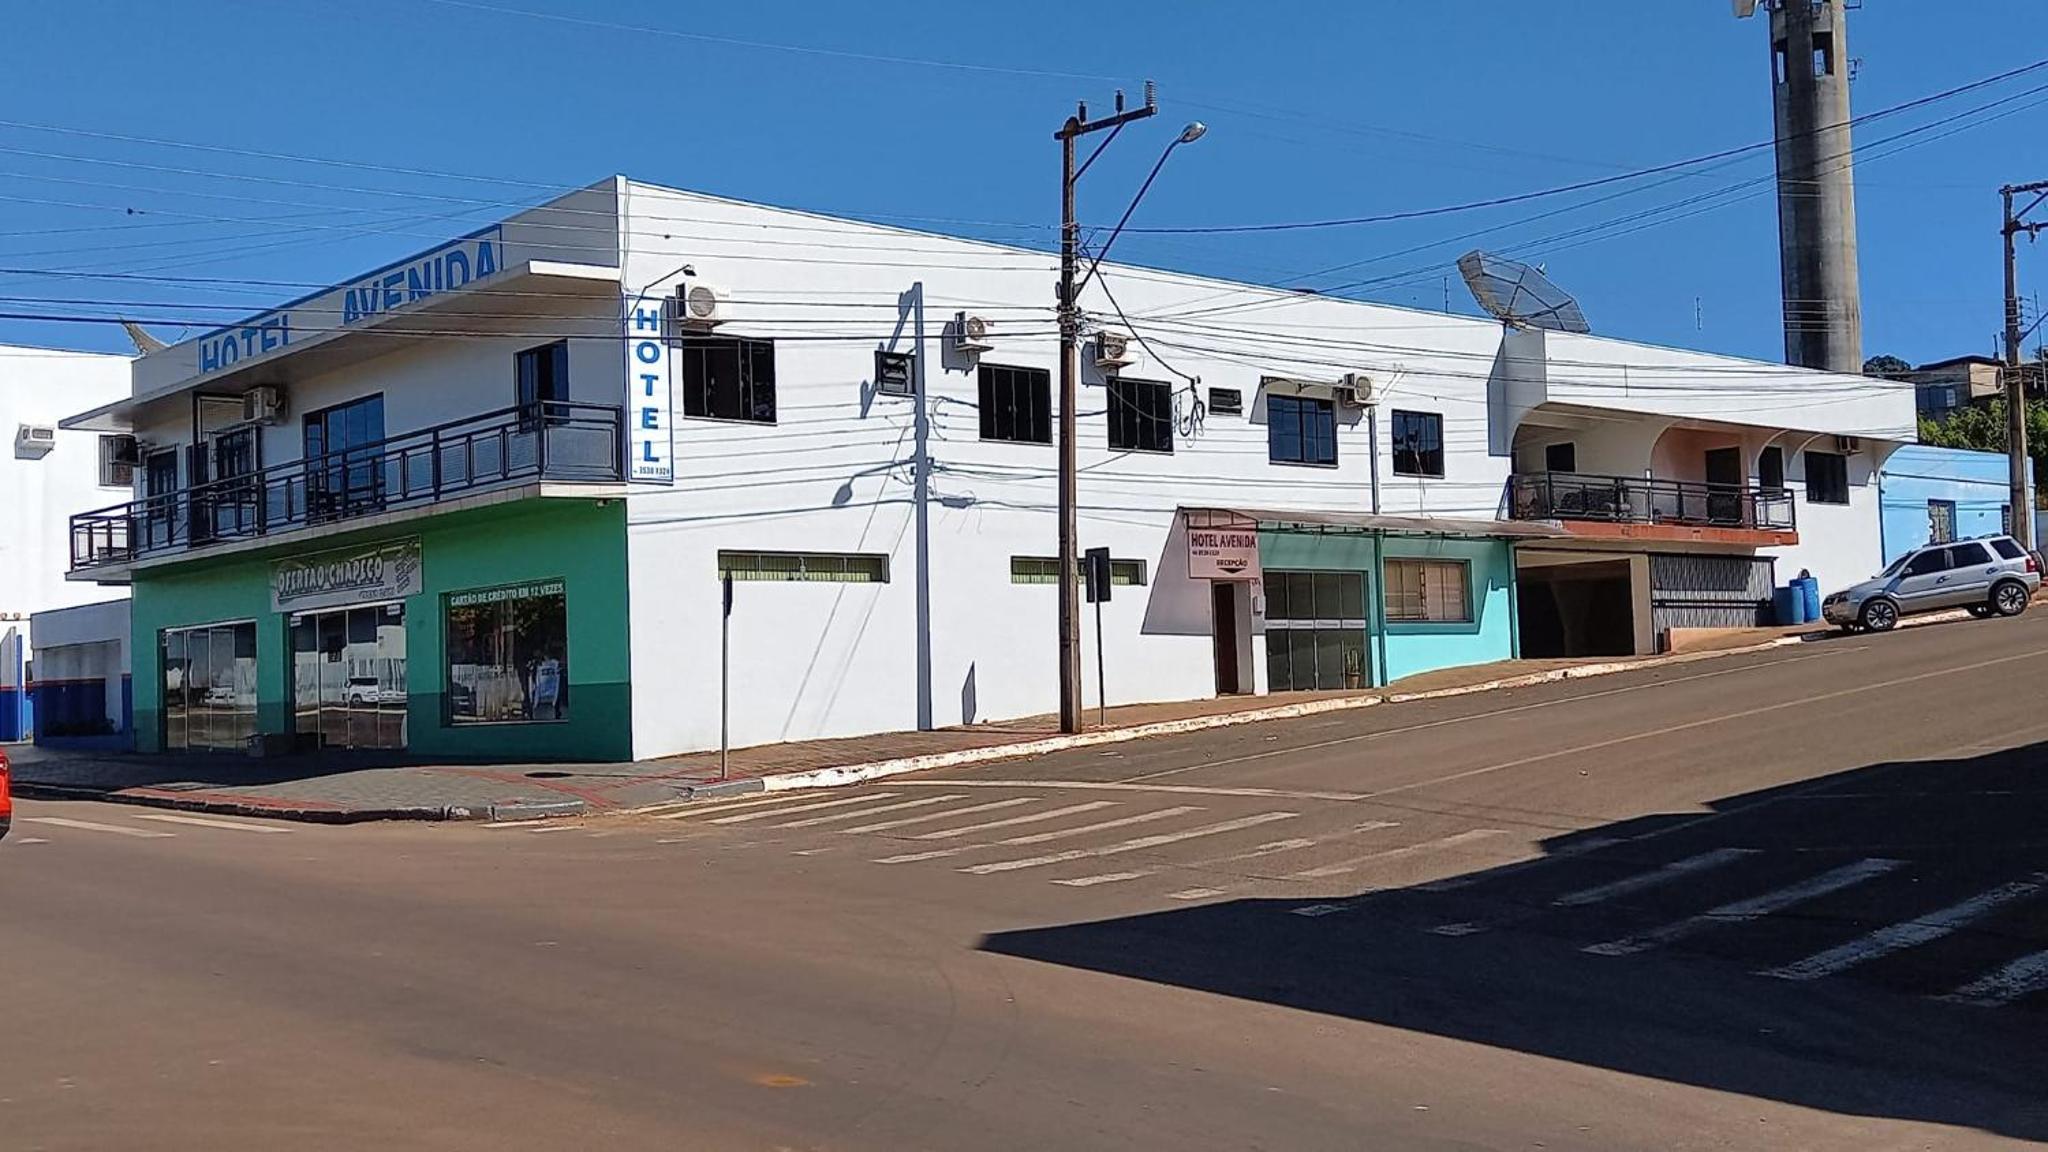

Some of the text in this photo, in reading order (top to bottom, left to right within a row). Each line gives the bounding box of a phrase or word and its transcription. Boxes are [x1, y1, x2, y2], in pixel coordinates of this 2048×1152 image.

[202, 239, 496, 374] HOTEL AVENIDA
[636, 308, 660, 463] HOTEL
[1191, 533, 1256, 548] HOTEL AVENIDA
[1216, 558, 1248, 567] RECEPÇÃO
[540, 583, 564, 596] VEZES
